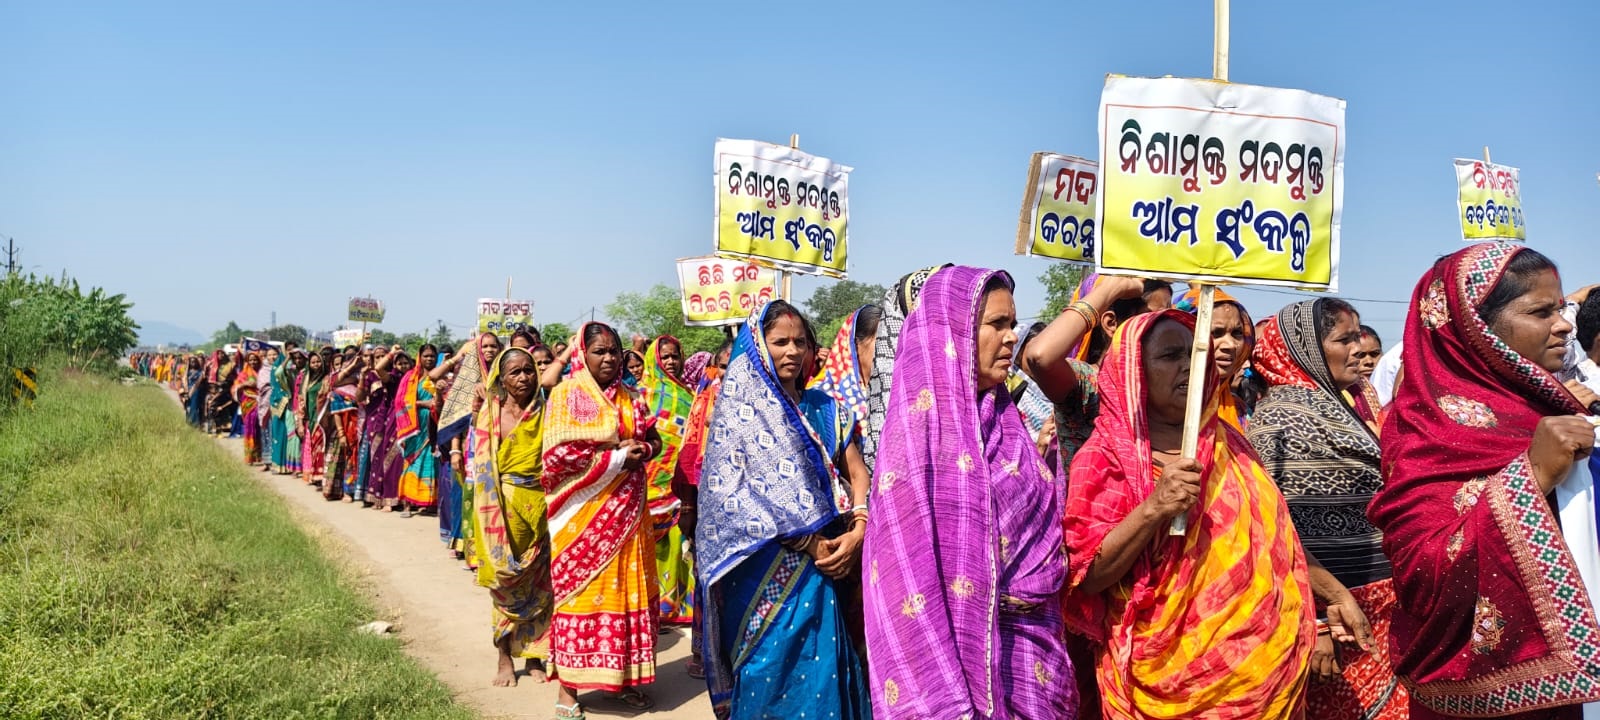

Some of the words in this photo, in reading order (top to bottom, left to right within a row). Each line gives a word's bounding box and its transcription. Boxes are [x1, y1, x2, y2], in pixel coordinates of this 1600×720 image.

[1053, 168, 1096, 205] ମଦ
[1119, 119, 1227, 193] ନିଶାମୁକ୍ତ
[1239, 139, 1324, 201] ମଦମୁକ୍ତ
[728, 162, 791, 208] ନିଶାମୁକ୍ତ
[796, 181, 841, 221] ମଦମୁକ୍ତ
[737, 211, 775, 240] ଆମ
[785, 217, 836, 262] ସଂକଳ୍ପ
[1132, 197, 1199, 245] ଆମ
[1215, 199, 1311, 272] ସଂକଳ୍ପ
[698, 263, 724, 286] ଛିଛି
[732, 265, 759, 282] ମଦ
